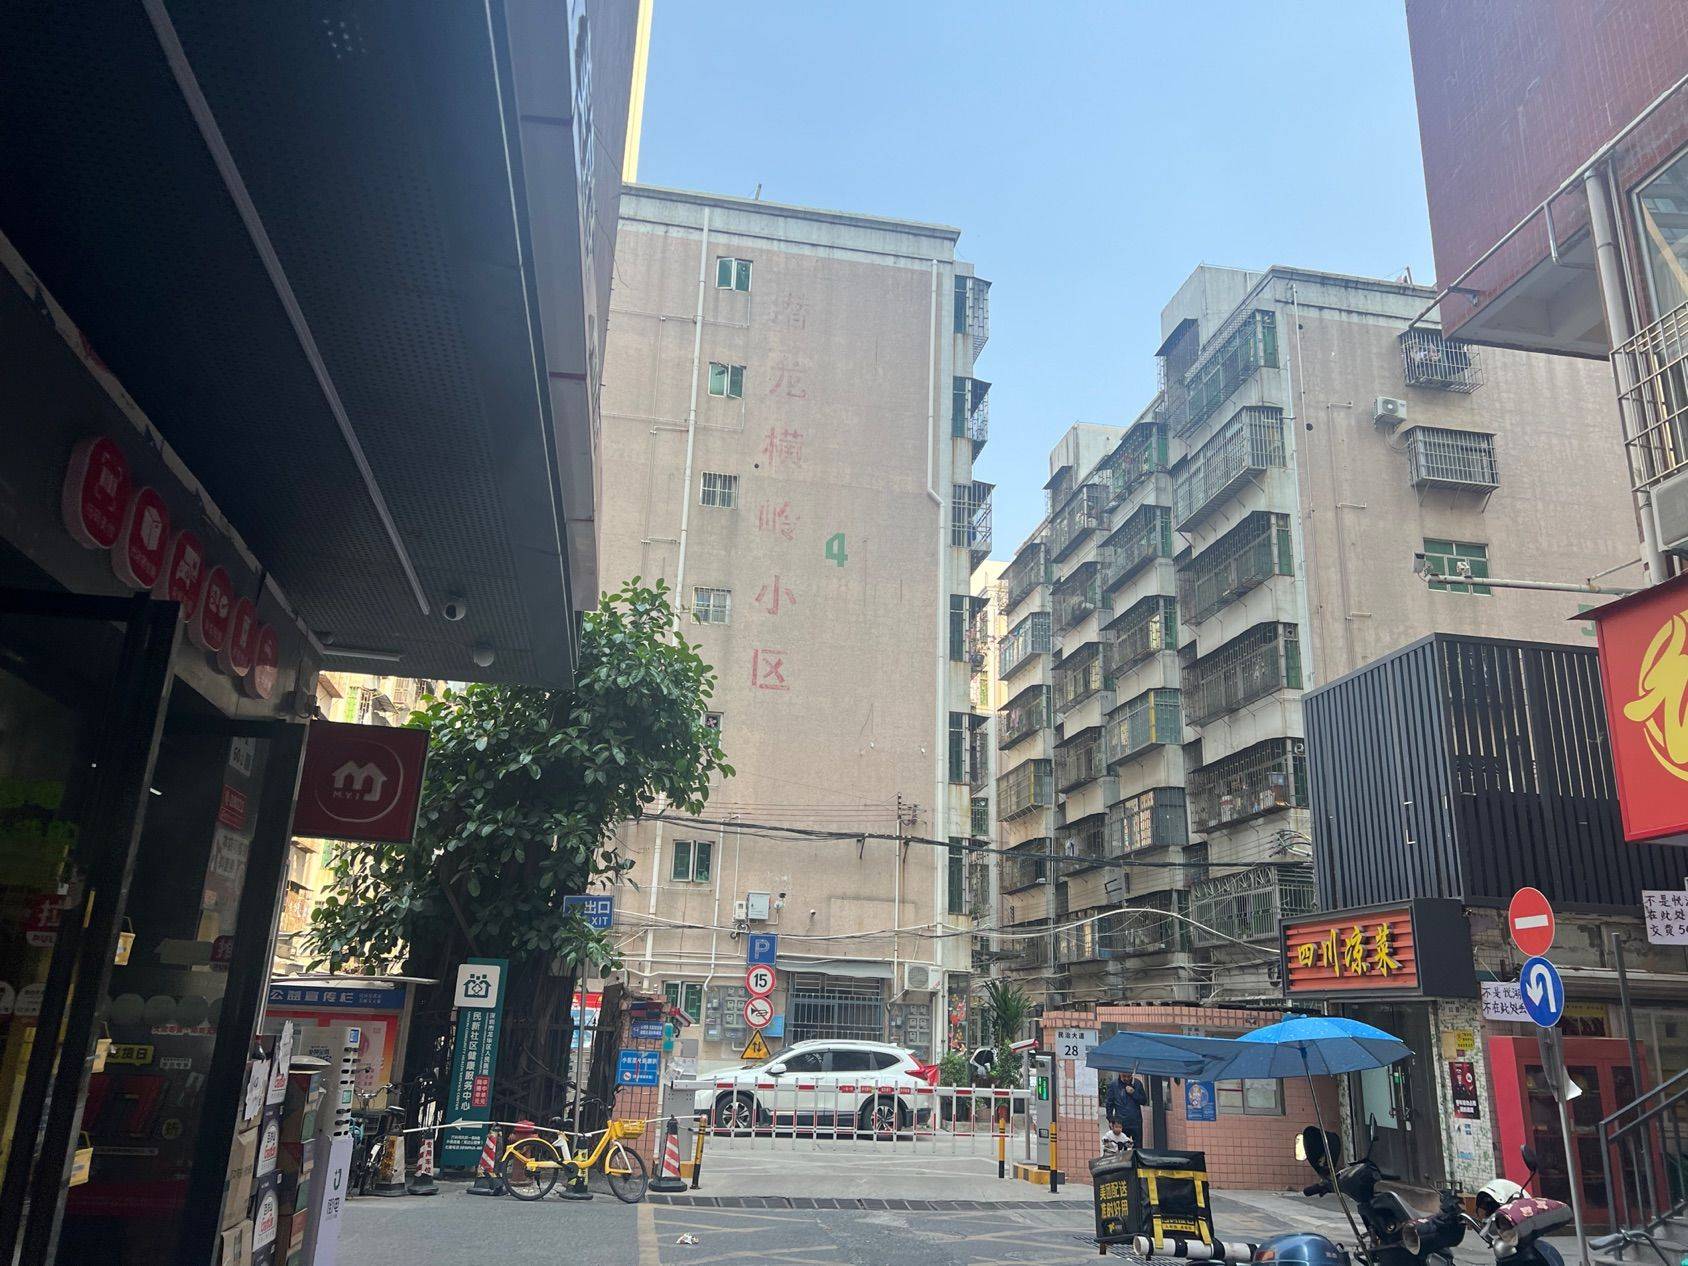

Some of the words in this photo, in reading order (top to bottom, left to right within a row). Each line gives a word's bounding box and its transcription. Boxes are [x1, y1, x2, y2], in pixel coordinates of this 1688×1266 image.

[825, 533, 848, 567] 4
[584, 900, 610, 914] 出口
[1644, 895, 1688, 907] 不是悦
[588, 916, 608, 925] XIT
[1650, 924, 1688, 936] 交费5
[755, 939, 770, 959] P
[1297, 922, 1404, 977] 四川凉菜
[754, 973, 767, 987] 15
[1058, 1031, 1085, 1039] 民治大道
[1065, 1045, 1079, 1056] 28
[460, 1011, 482, 1111] 民新社区健康服务中心
[1100, 1180, 1127, 1200] 美团配送
[1101, 1200, 1129, 1217] 准时好用
